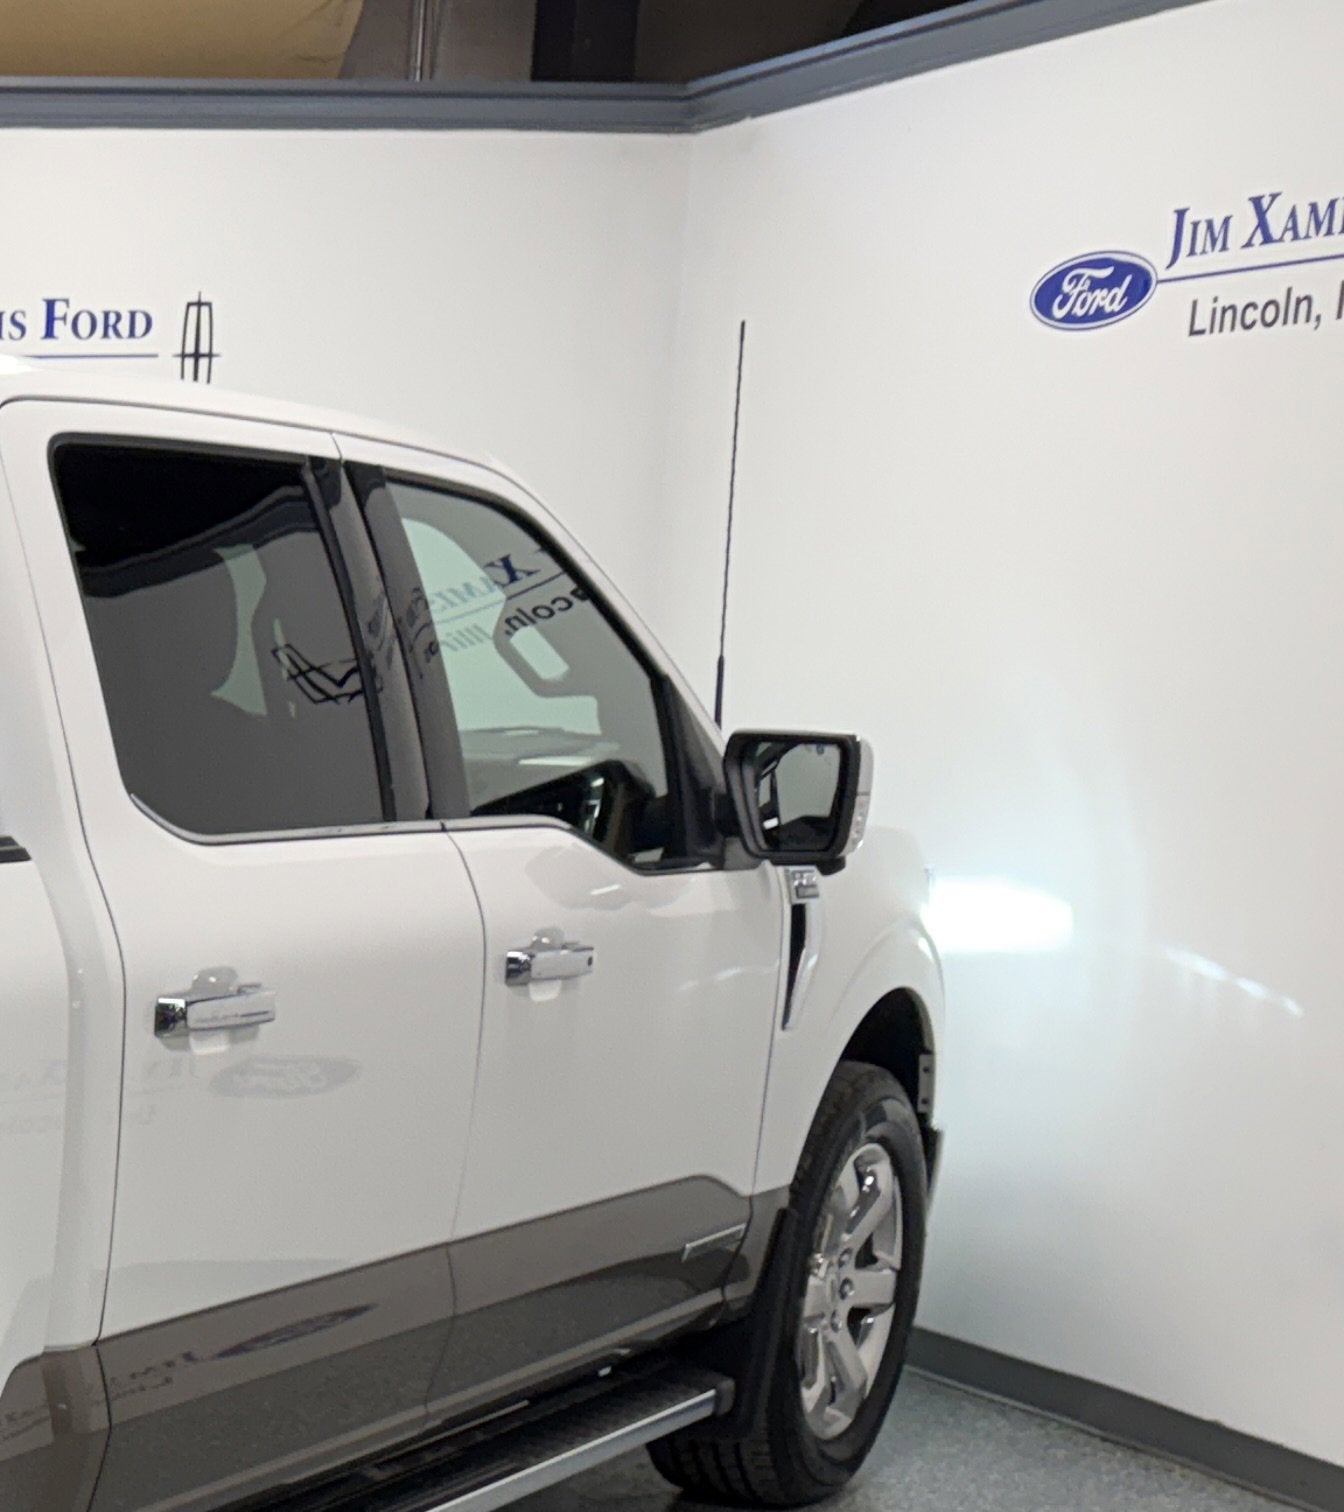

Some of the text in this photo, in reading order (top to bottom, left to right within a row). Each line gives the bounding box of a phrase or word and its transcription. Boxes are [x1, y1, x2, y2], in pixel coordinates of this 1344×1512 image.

[1165, 207, 1233, 270] JIM
[40, 298, 153, 341] FORD
[1052, 266, 1133, 320] Ford
[1188, 286, 1322, 338] Lincoln,
